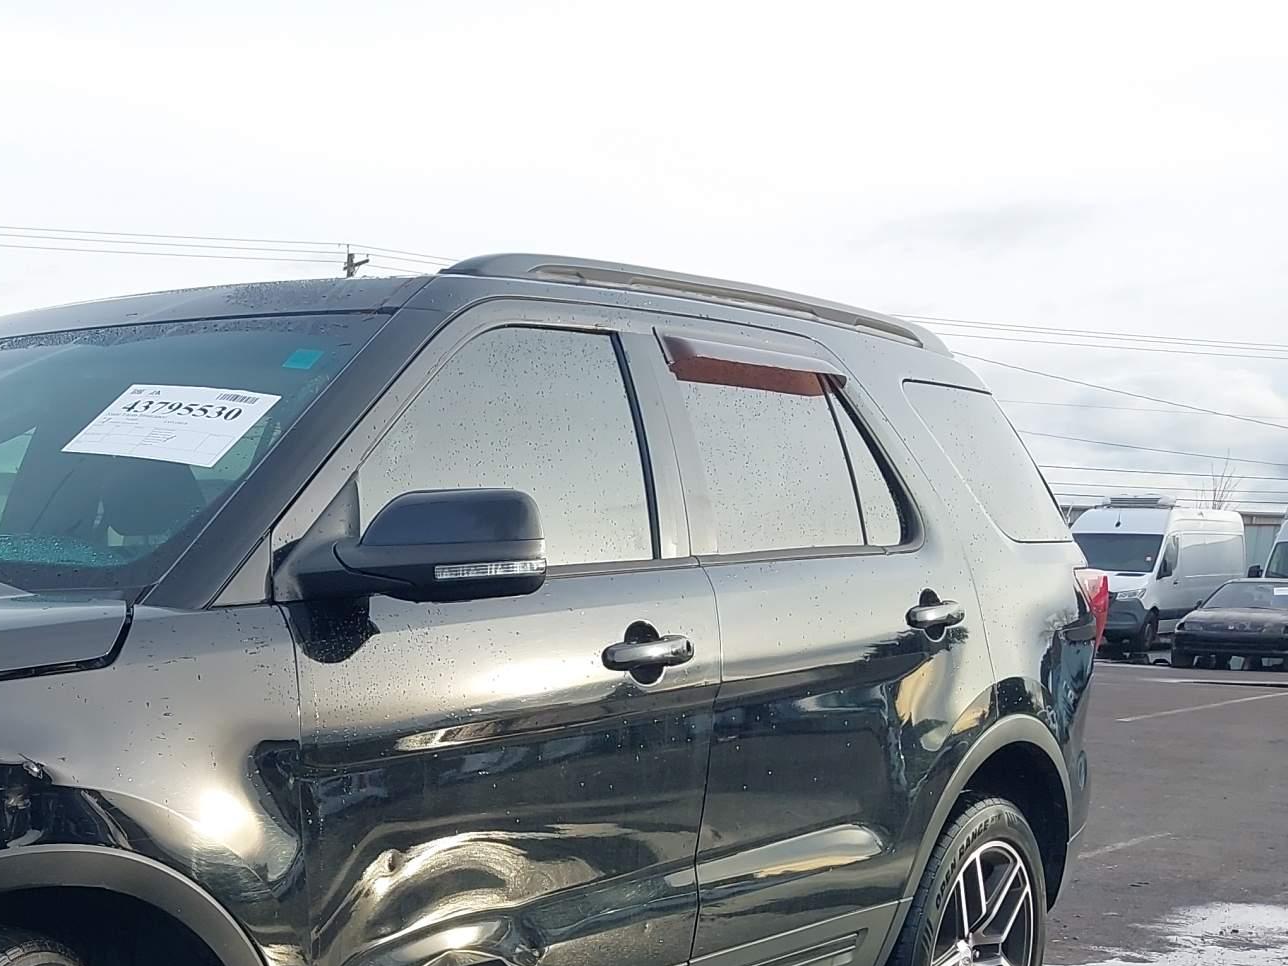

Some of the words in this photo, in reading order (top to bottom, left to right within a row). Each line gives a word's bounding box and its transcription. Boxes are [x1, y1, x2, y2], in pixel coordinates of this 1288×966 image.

[121, 399, 243, 421] 43795530
[935, 859, 957, 910] OPEN
[958, 820, 990, 861] RANGE
